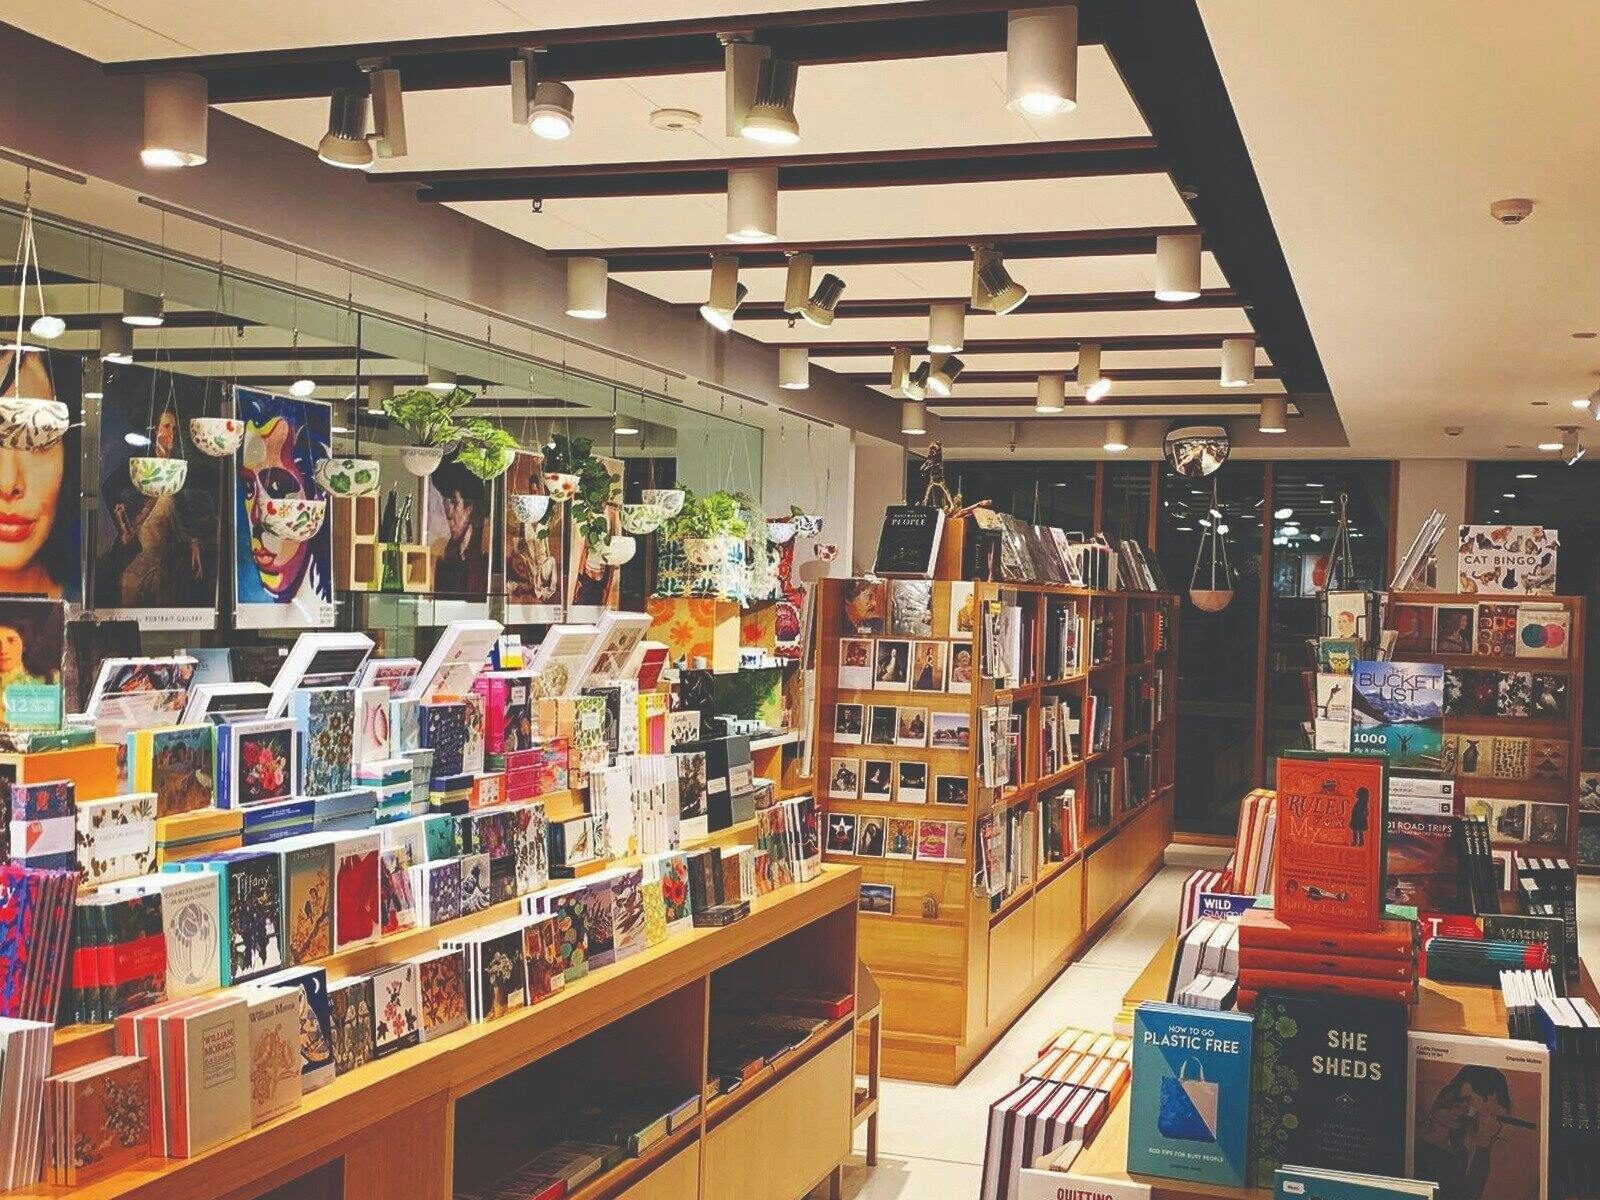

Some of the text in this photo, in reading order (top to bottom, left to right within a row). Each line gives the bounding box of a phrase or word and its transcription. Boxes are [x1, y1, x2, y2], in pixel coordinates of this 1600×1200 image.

[1464, 555, 1536, 566] CAT BINGO
[1360, 672, 1443, 690] BUCKET
[1380, 687, 1420, 702] LIST
[1354, 732, 1388, 744] 1000
[1288, 795, 1349, 818] RULES
[1290, 816, 1321, 845] MY
[1398, 821, 1425, 832] ROAD
[1428, 823, 1453, 834] TRIPS
[1204, 898, 1231, 910] WILD
[249, 1010, 276, 1022] William
[1168, 1025, 1215, 1037] HOW TO GO
[1144, 1031, 1239, 1054] PLASTIC FREE
[1327, 1029, 1368, 1051] SHE
[1311, 1055, 1382, 1081] SHEDS
